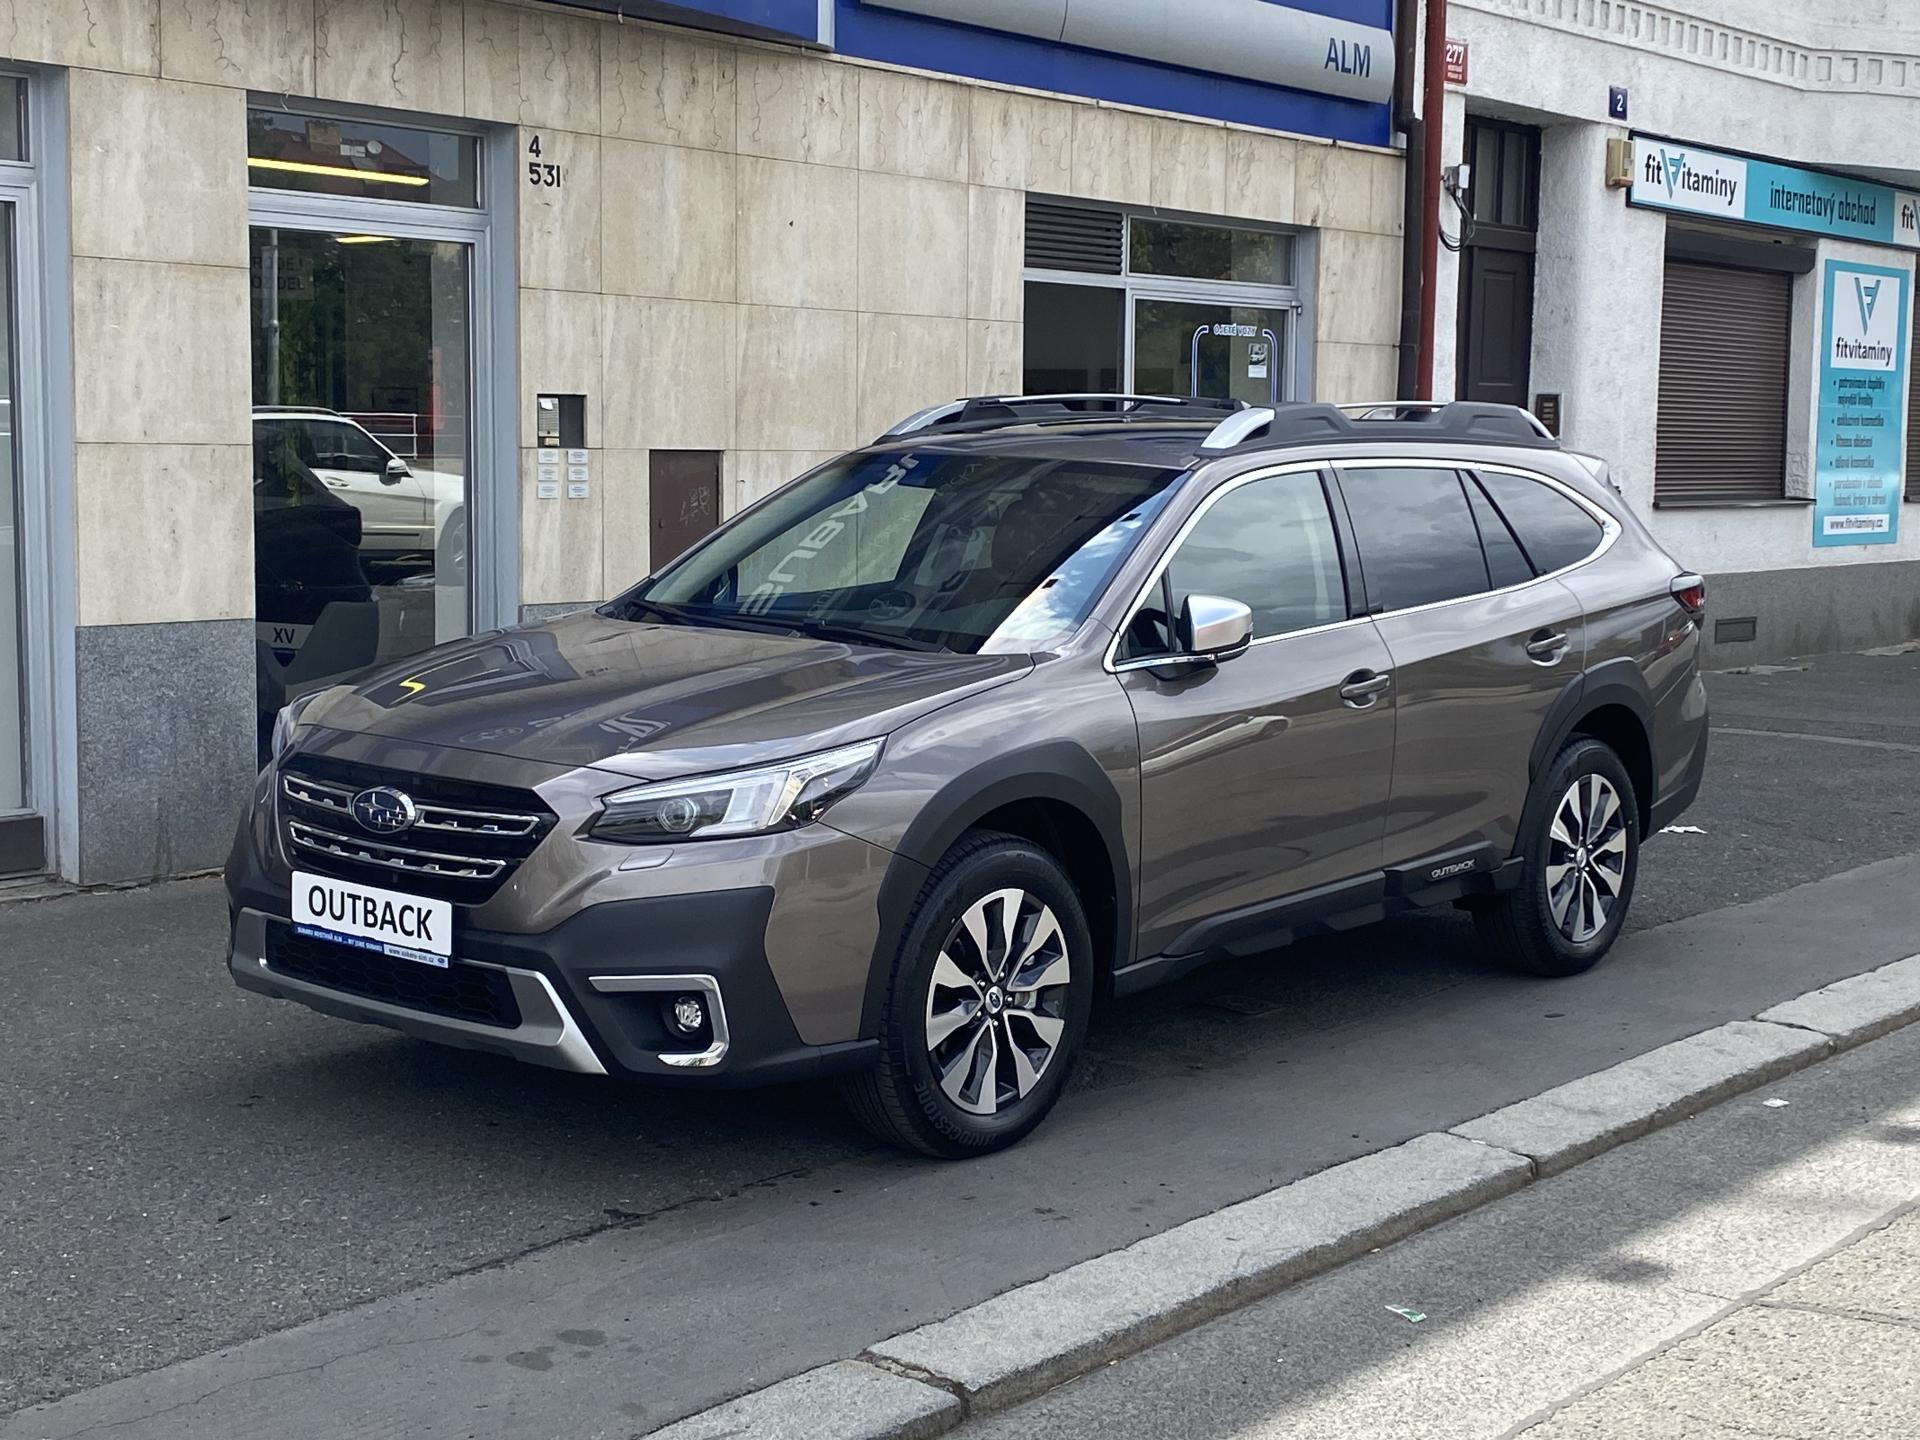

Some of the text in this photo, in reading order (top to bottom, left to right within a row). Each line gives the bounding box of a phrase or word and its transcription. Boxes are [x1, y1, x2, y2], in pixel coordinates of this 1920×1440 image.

[1324, 37, 1371, 78] ALM
[1446, 44, 1464, 64] 277
[1616, 94, 1624, 112] 2
[529, 135, 541, 158] 4
[529, 162, 561, 188] 531
[1770, 180, 1877, 226] internetový obchod
[1836, 337, 1892, 367] fitvitaminy
[273, 627, 295, 644] XV
[1431, 859, 1475, 878] OUTBACK
[309, 885, 432, 941] OUTBACK
